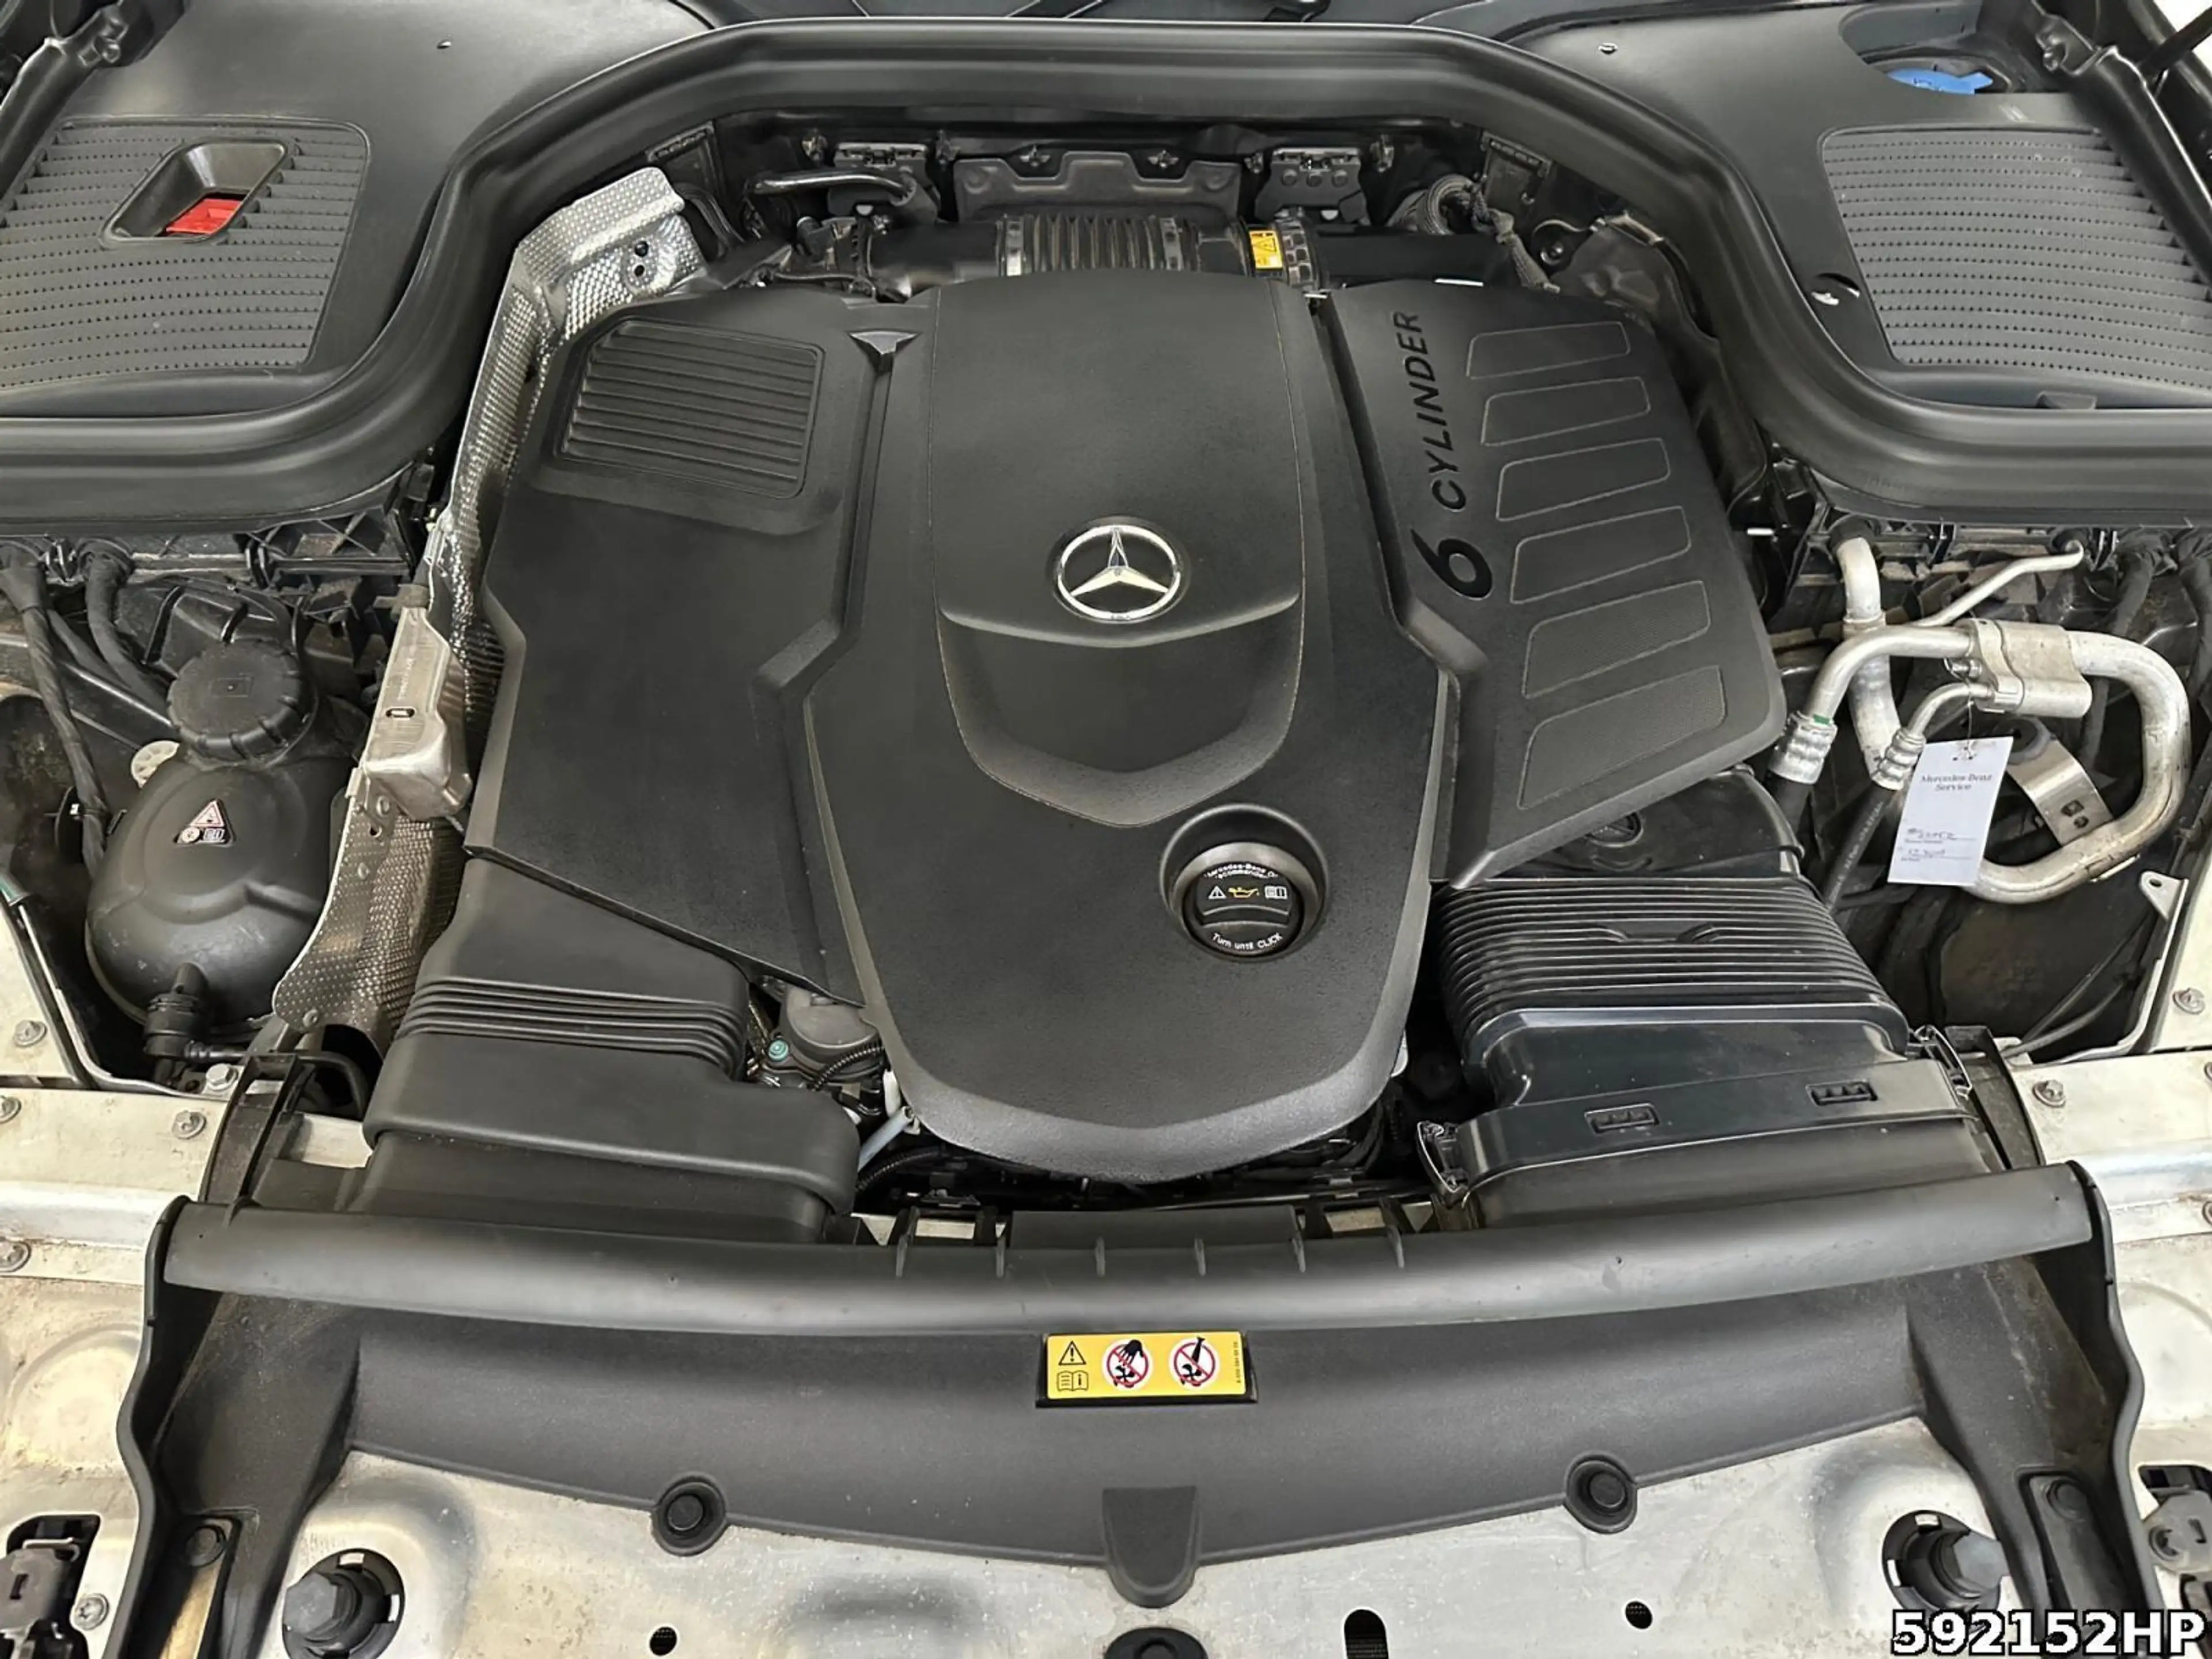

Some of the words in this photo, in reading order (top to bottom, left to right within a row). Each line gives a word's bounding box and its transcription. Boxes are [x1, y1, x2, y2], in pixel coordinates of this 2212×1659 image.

[1393, 310, 1467, 512] CYLINDER
[1410, 528, 1493, 600] 6
[1212, 933, 1232, 948] Turn
[1234, 941, 1254, 950] until
[1257, 932, 1283, 948] CLICK
